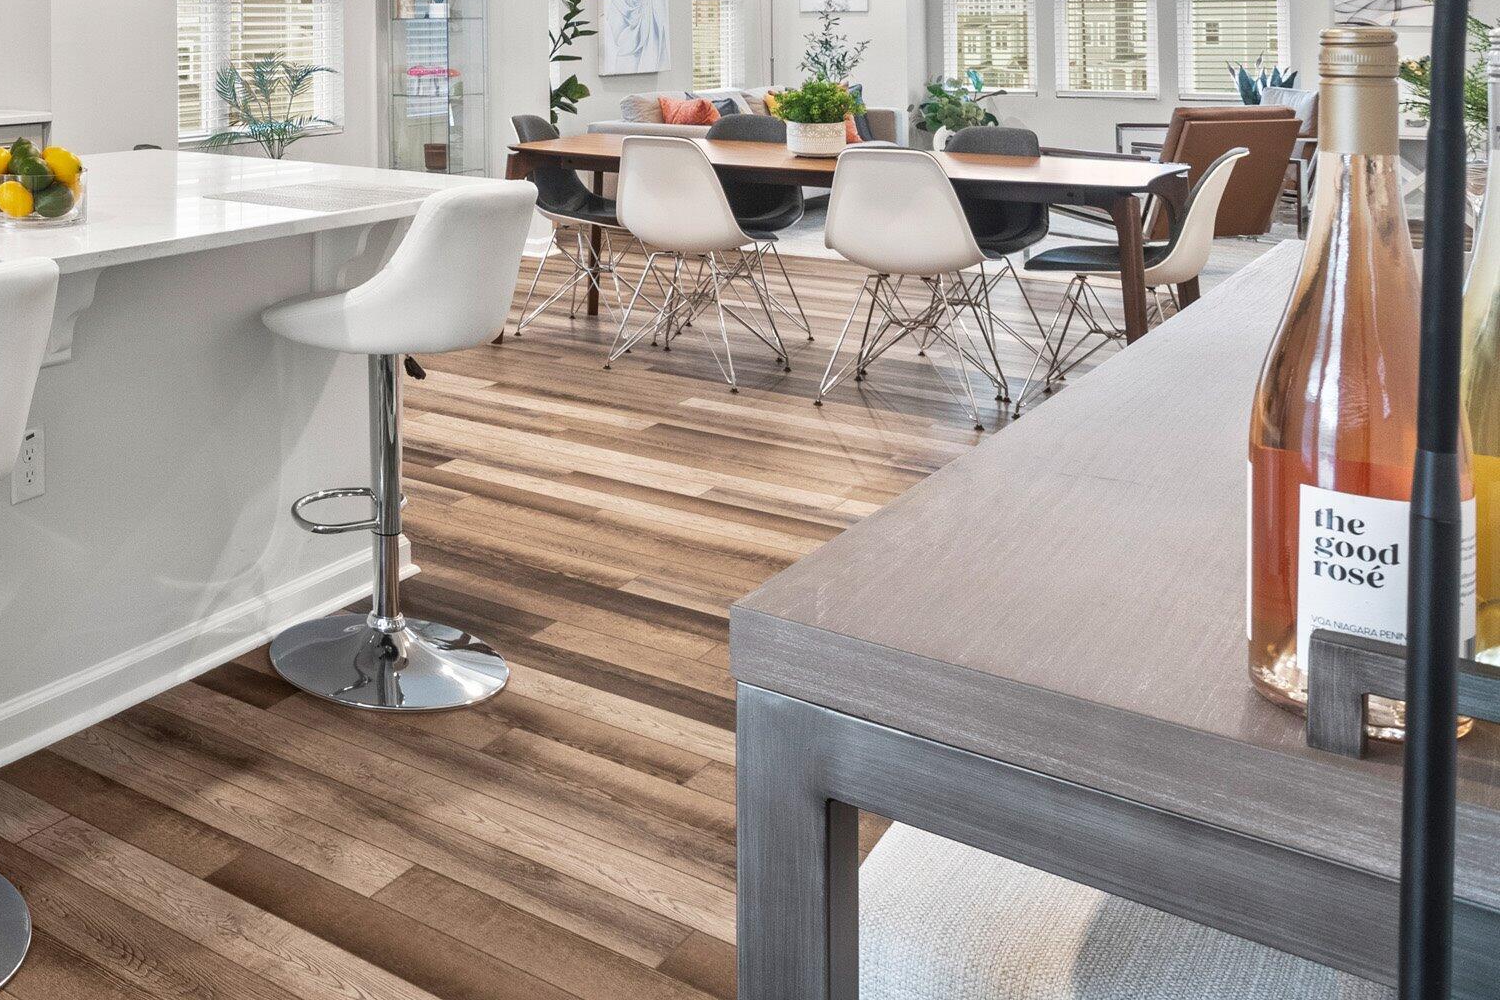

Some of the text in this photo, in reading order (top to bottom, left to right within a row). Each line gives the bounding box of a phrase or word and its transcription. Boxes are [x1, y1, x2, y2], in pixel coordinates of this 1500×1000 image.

[1314, 508, 1365, 536] the
[1314, 536, 1400, 566] good
[1314, 560, 1385, 588] rosé
[1333, 620, 1378, 638] NIAGARA
[1379, 629, 1407, 641] PENIN
